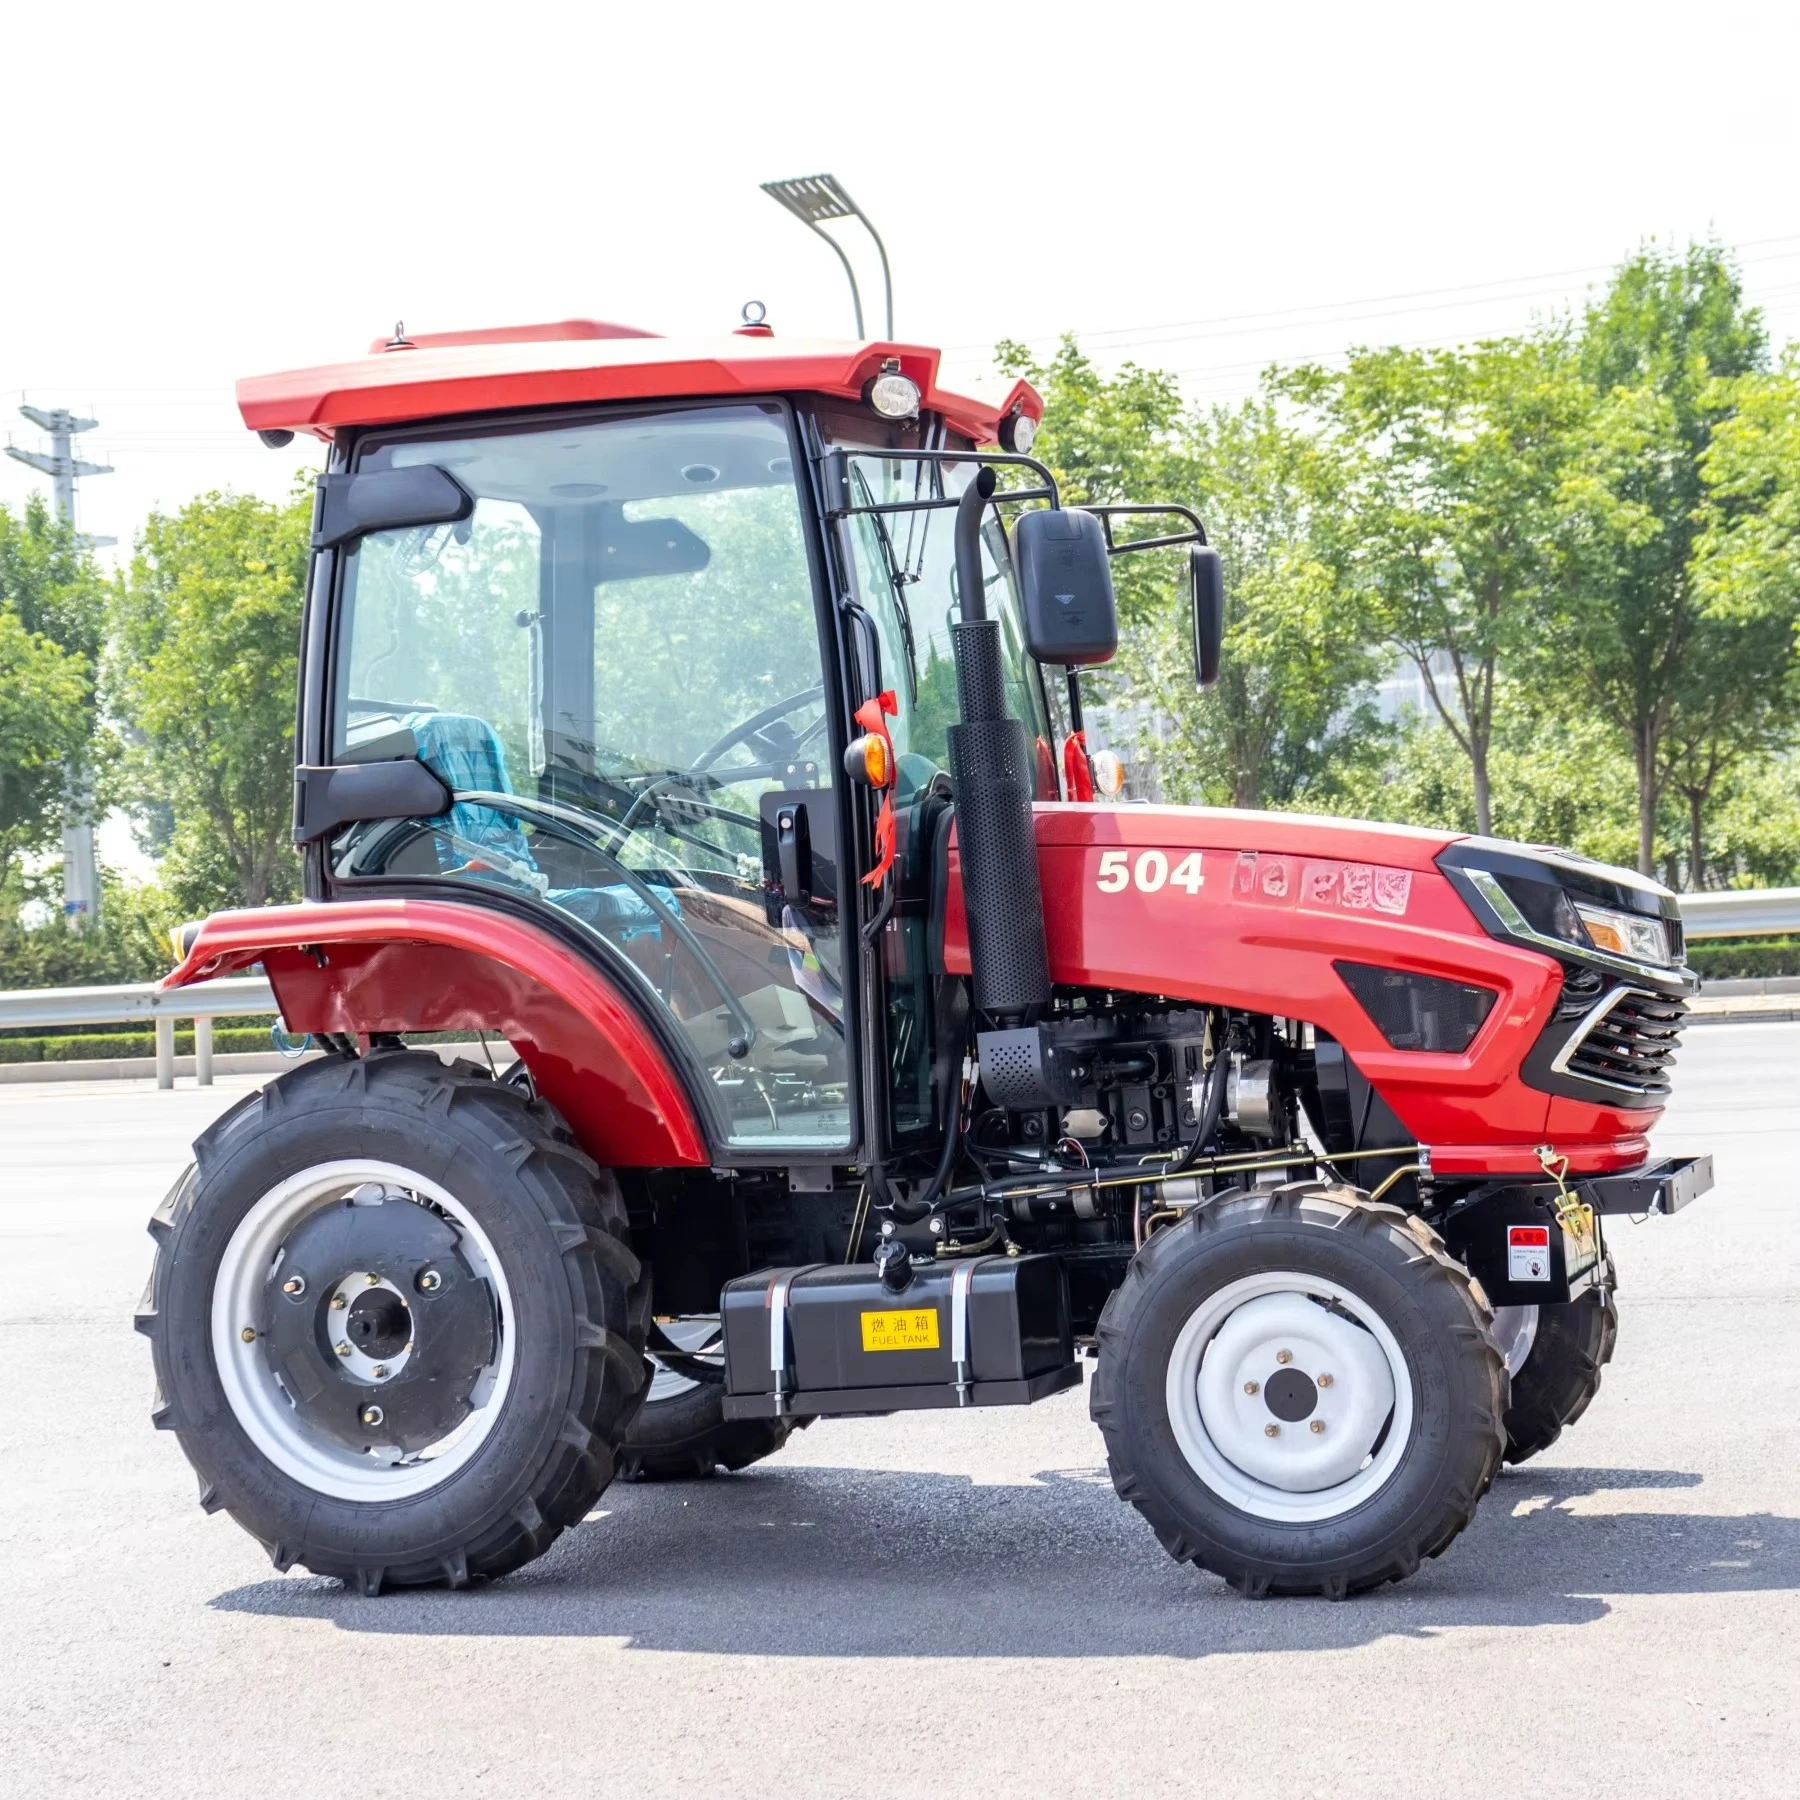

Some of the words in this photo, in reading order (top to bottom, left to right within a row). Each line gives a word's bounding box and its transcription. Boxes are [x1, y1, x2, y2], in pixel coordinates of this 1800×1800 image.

[1097, 850, 1205, 894] 504
[872, 1315, 928, 1332] 燃油箱
[872, 1336, 899, 1345] FUEL
[902, 1334, 929, 1343] TANK
